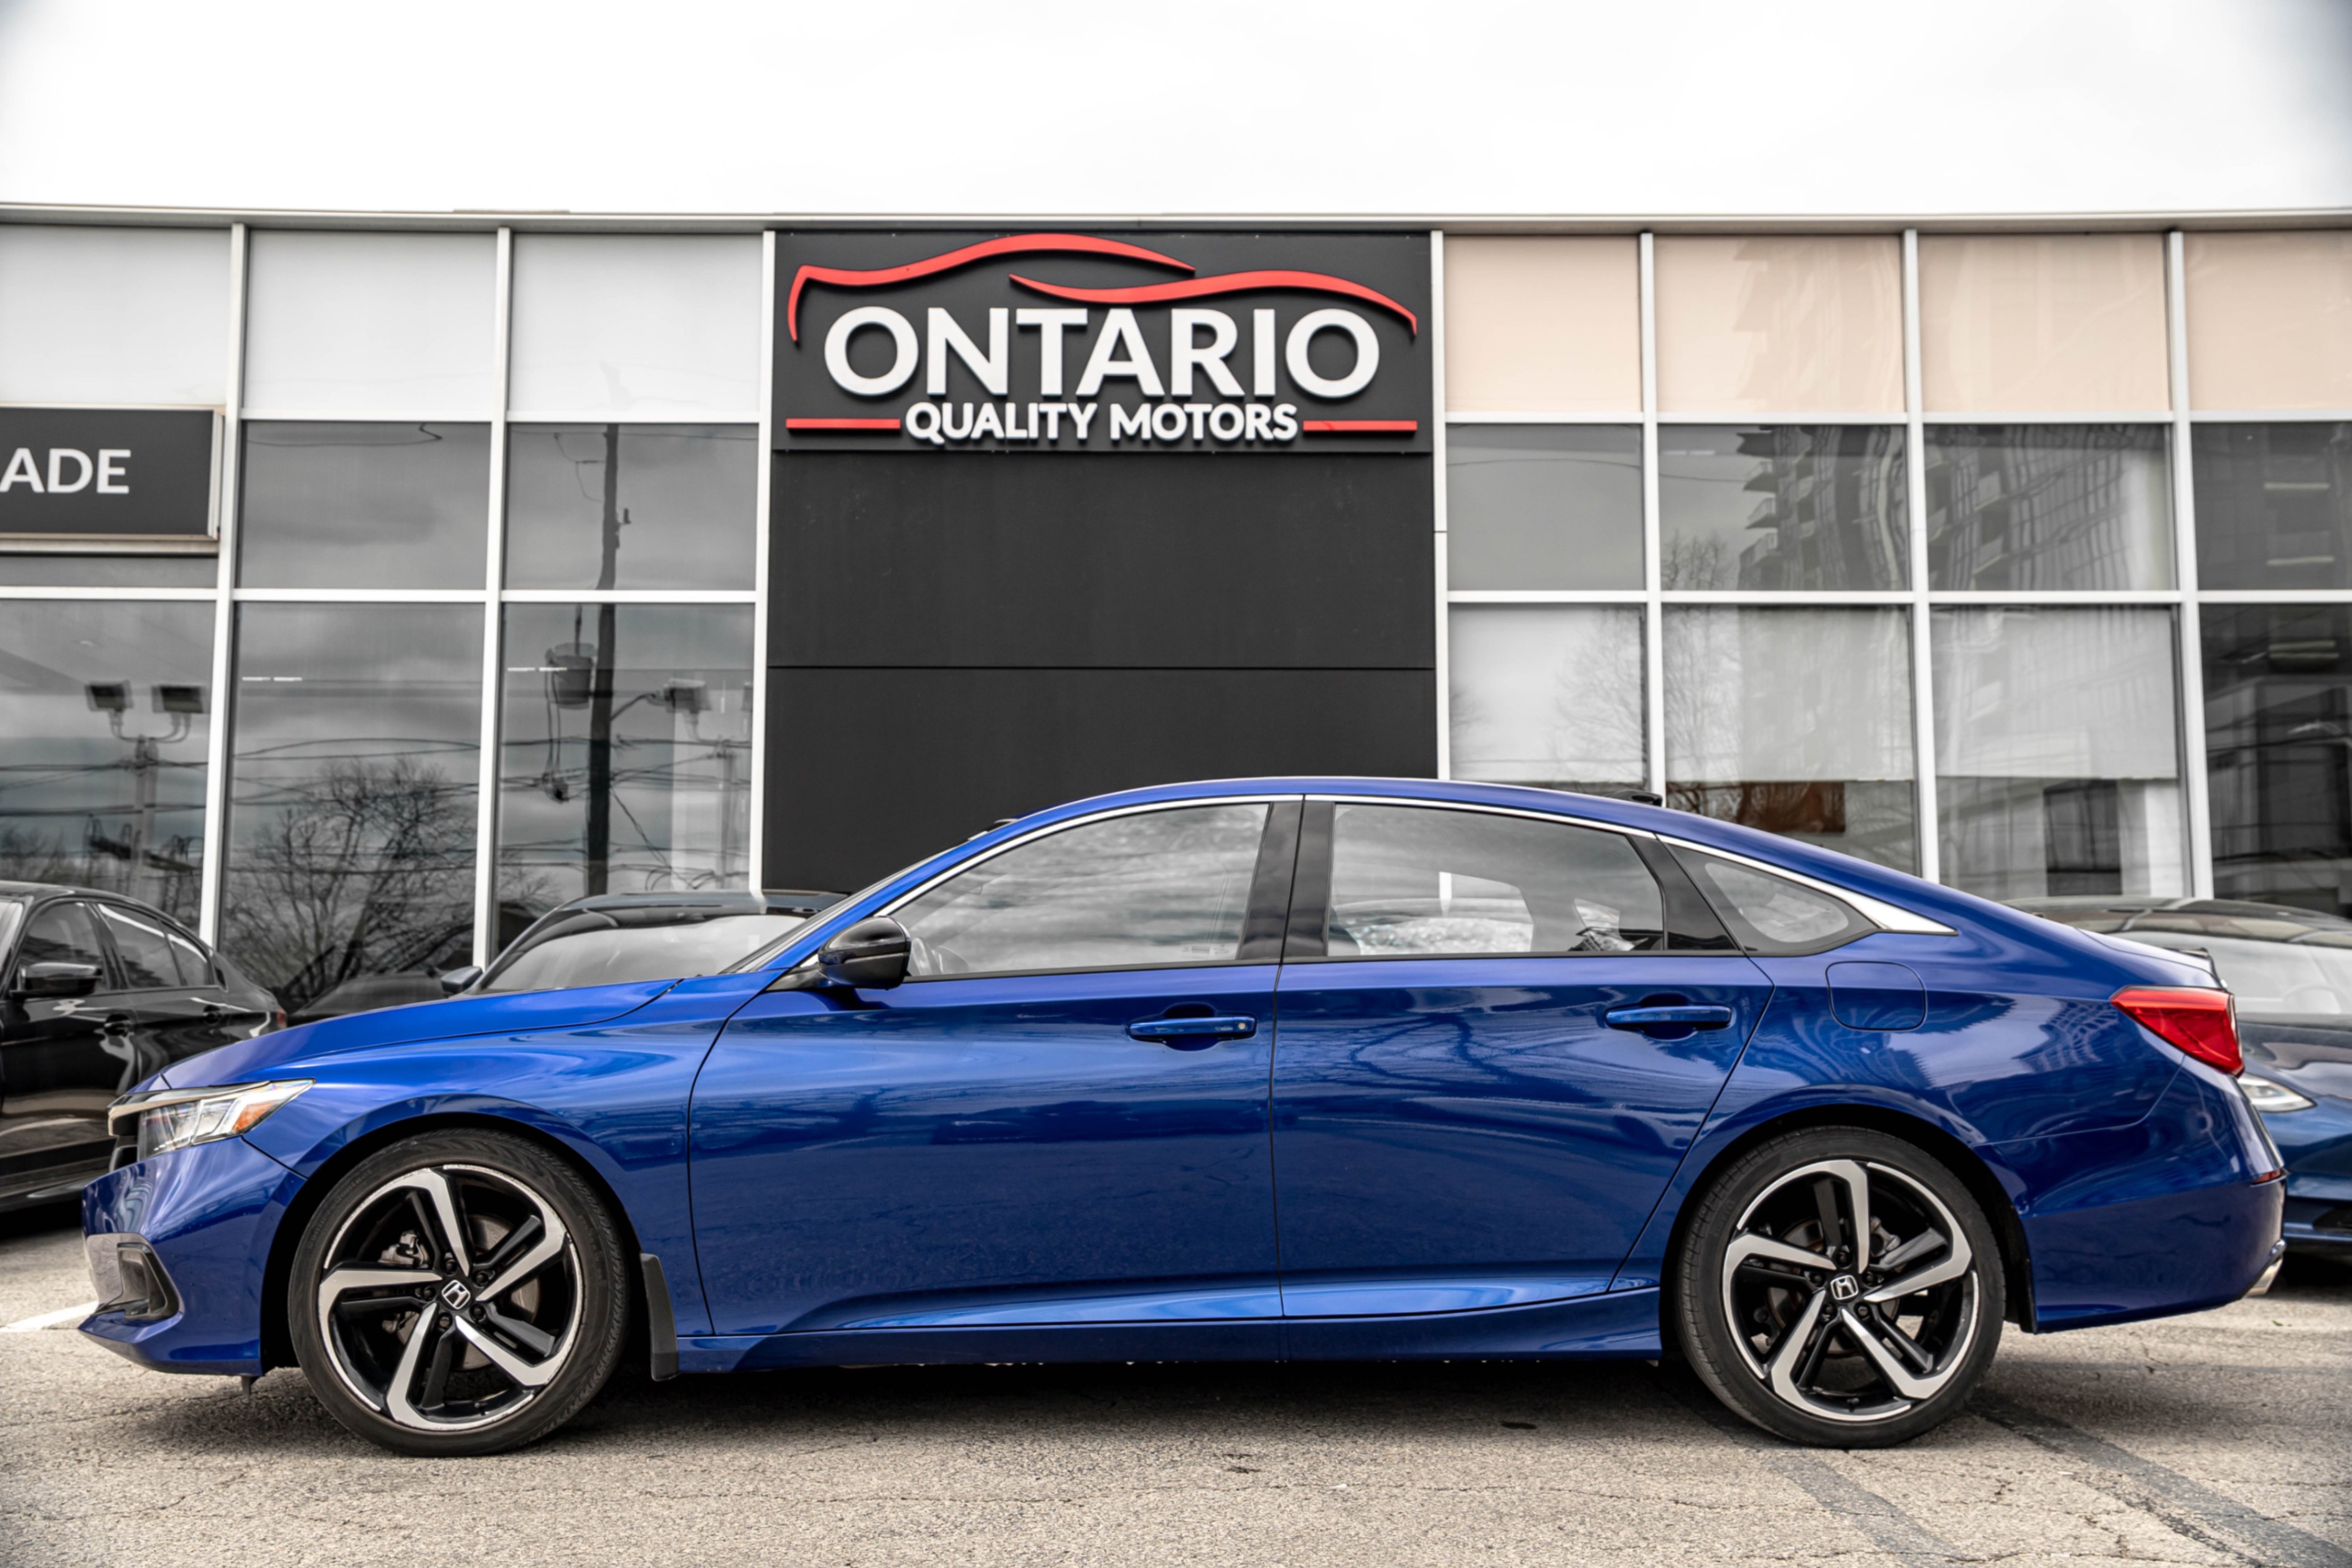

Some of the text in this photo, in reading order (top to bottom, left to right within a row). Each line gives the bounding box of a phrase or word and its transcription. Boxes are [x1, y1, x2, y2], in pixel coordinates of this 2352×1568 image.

[824, 306, 1380, 398] ONTARIO
[905, 401, 1299, 444] QUALITY MOTORS
[0, 447, 132, 494] ADE
